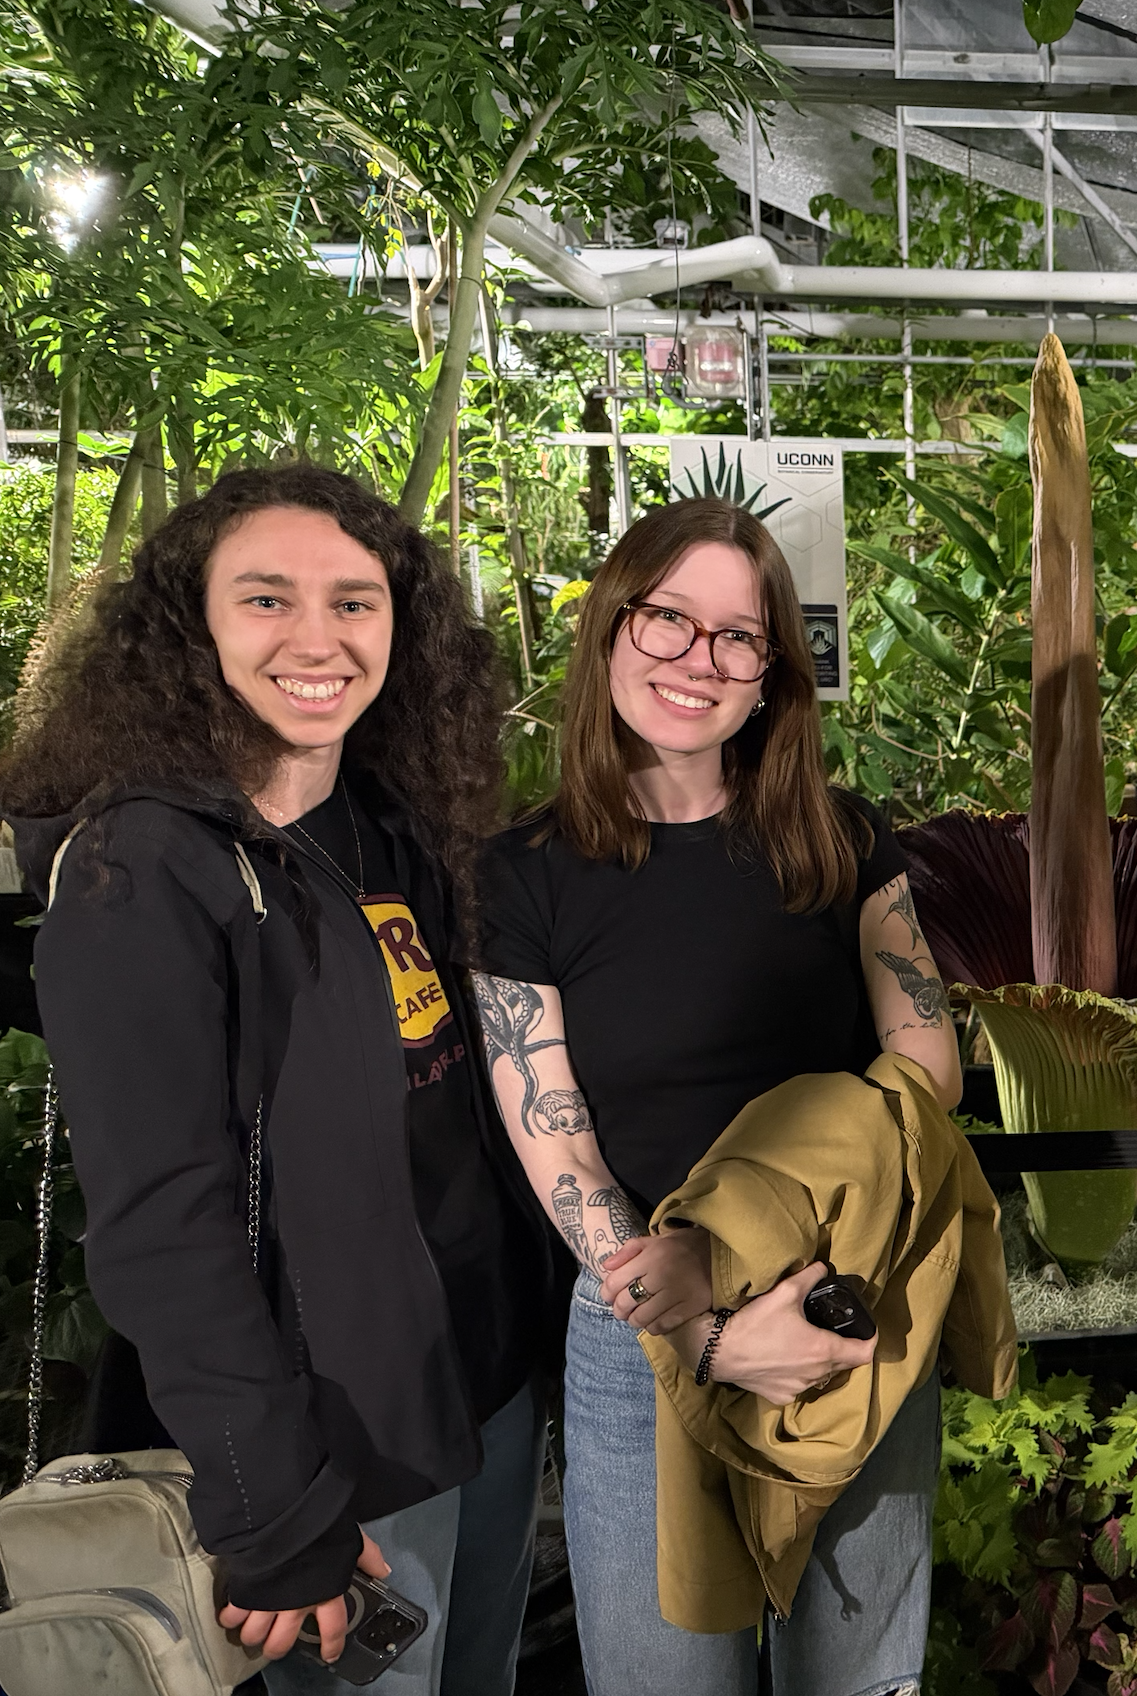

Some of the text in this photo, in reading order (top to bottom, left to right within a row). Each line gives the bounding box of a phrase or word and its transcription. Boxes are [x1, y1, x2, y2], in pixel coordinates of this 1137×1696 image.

[777, 452, 834, 466] UCONN
[375, 917, 436, 973] R
[395, 981, 443, 1024] CAFE
[558, 1207, 577, 1218] TRUE
